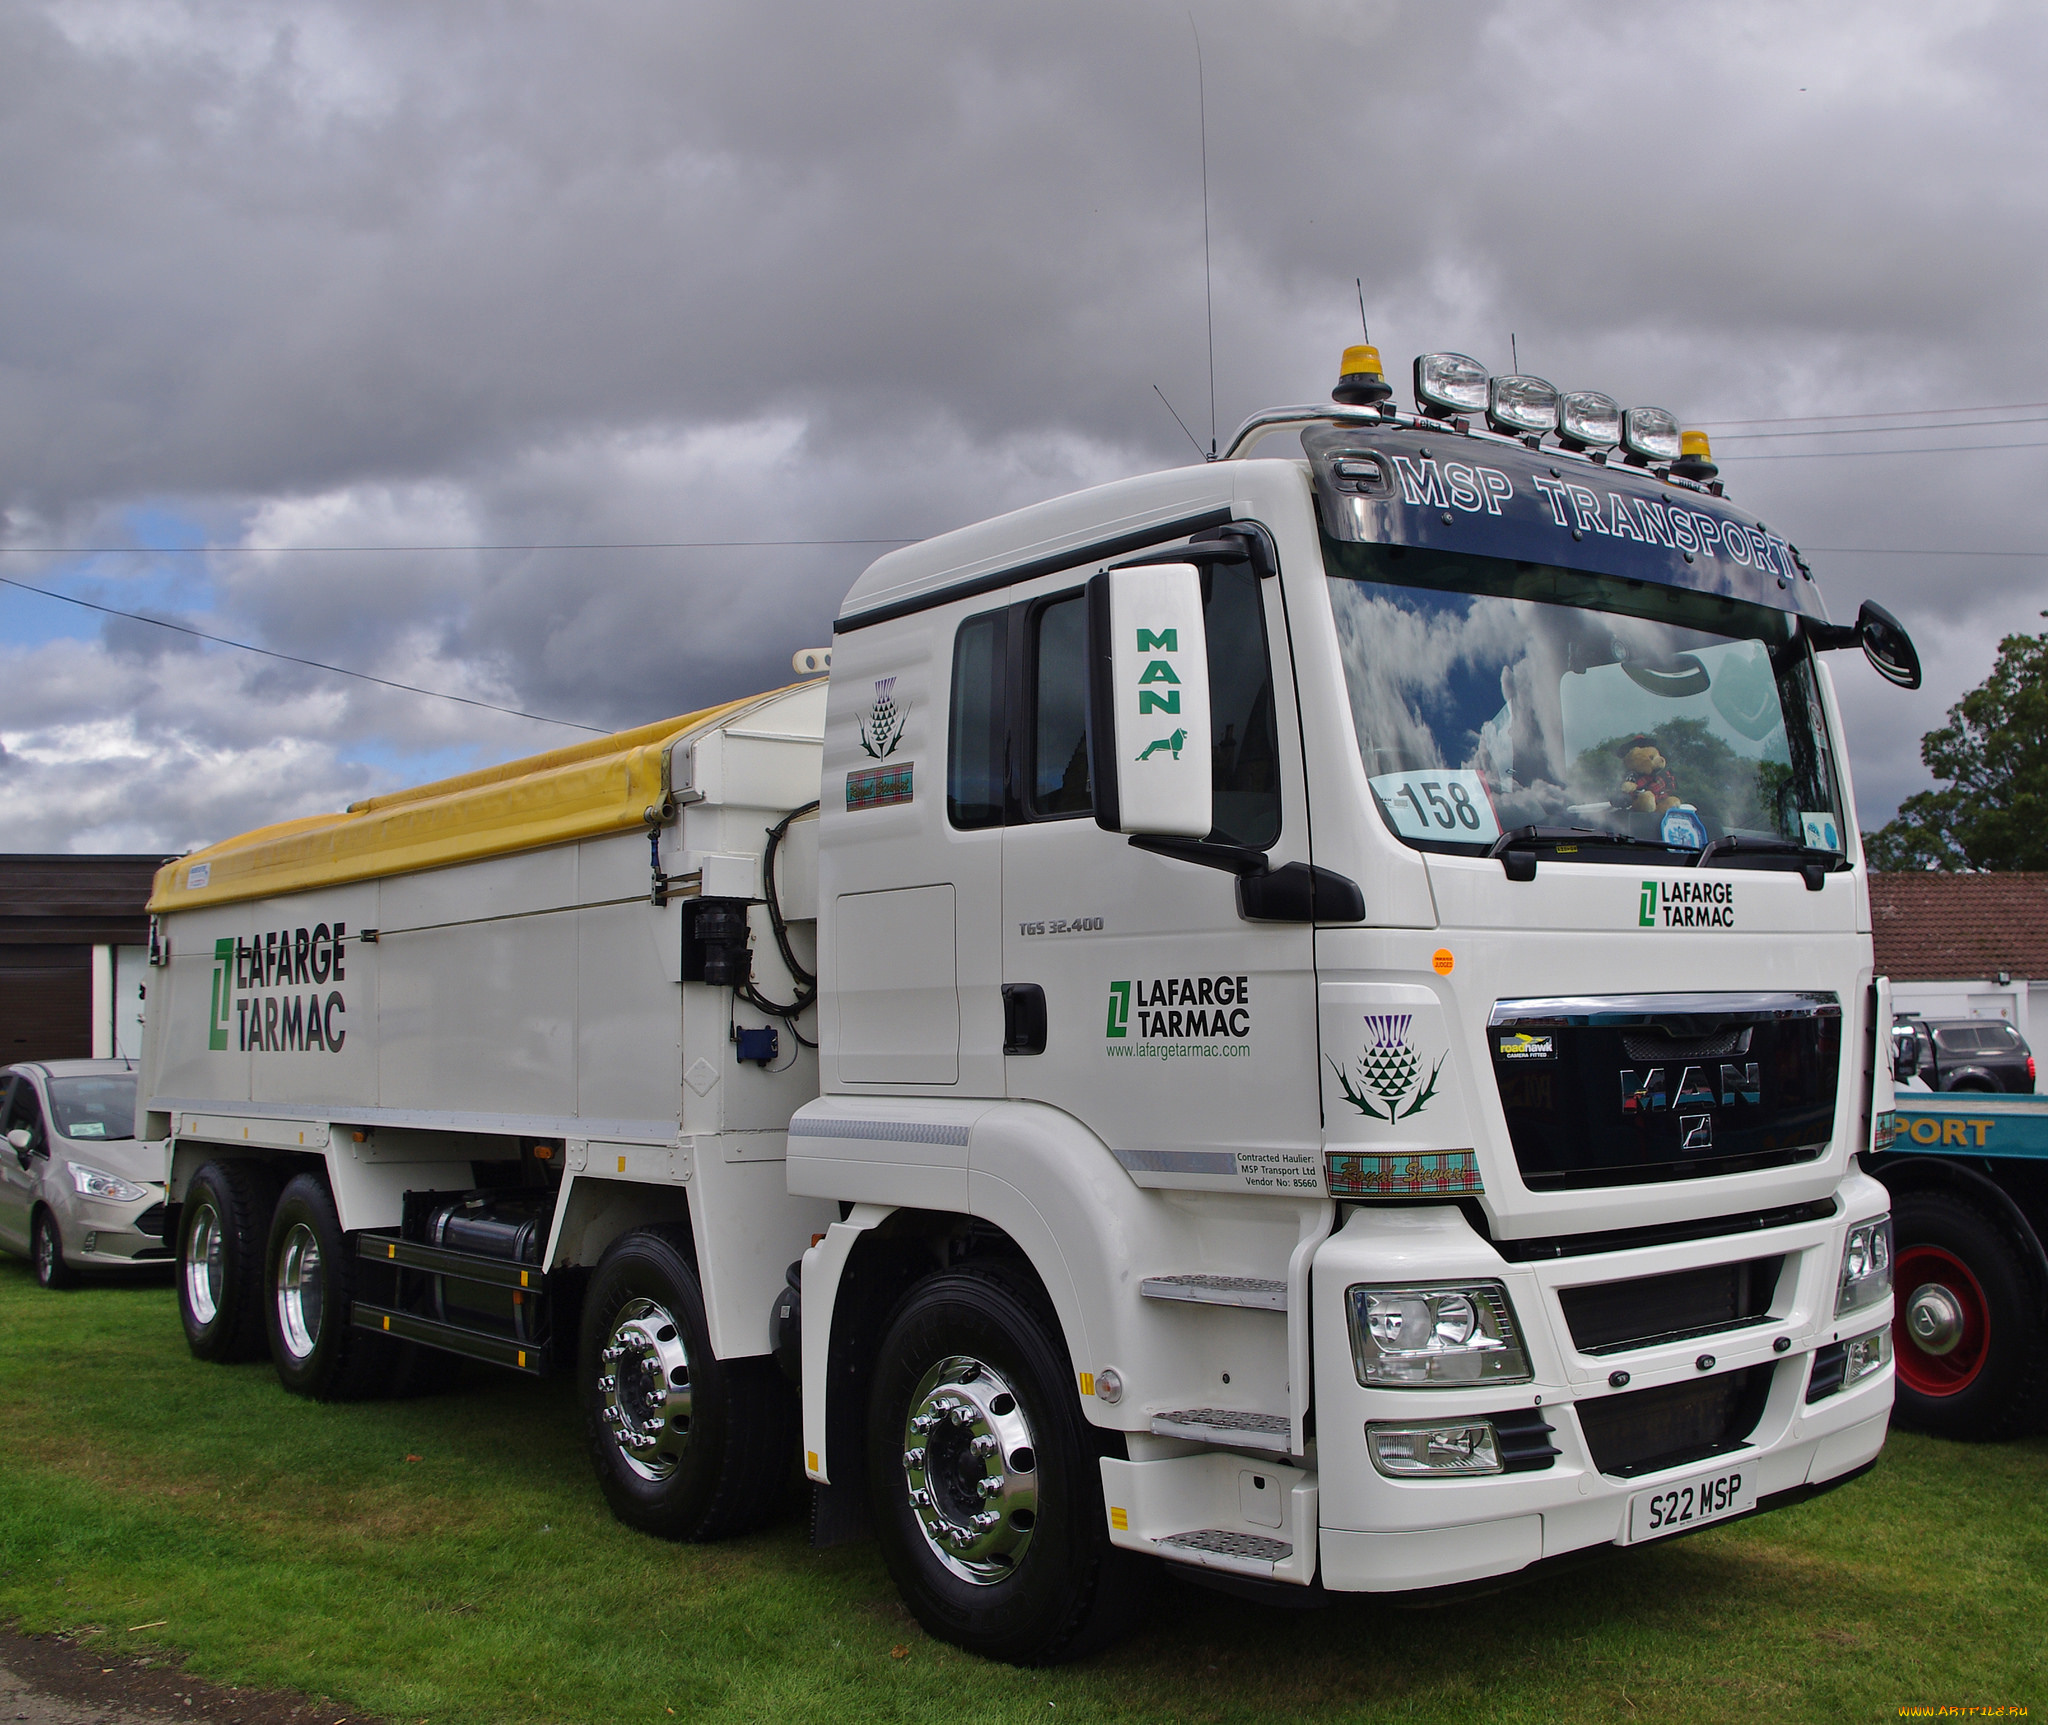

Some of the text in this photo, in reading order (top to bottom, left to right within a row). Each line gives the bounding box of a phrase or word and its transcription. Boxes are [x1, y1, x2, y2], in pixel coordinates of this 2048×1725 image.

[1391, 455, 1795, 580] MSP TRANSPORT
[1136, 628, 1182, 715] MAN
[1396, 782, 1480, 830] 158
[1661, 881, 1733, 904] LAFARGE
[1018, 916, 1105, 937] TGS 32.400
[1662, 905, 1735, 928] TARMAC
[237, 921, 346, 990] LAFARGE
[1136, 975, 1249, 1007] LAFARGE
[237, 990, 346, 1054] TARMAC
[1137, 1008, 1251, 1038] TARMAC
[1105, 1042, 1251, 1062] www.lafargetarmac.com
[1500, 1041, 1553, 1053] roadhawk
[1620, 1062, 1761, 1114] MAN
[1237, 1152, 1315, 1164] Contracted Haulier:
[1241, 1165, 1316, 1177] MSP Transport Ltd
[1245, 1176, 1318, 1188] Vendor No: 85660
[1341, 1161, 1468, 1188] Royal Stewart
[1649, 1473, 1742, 1530] S22 MSP
